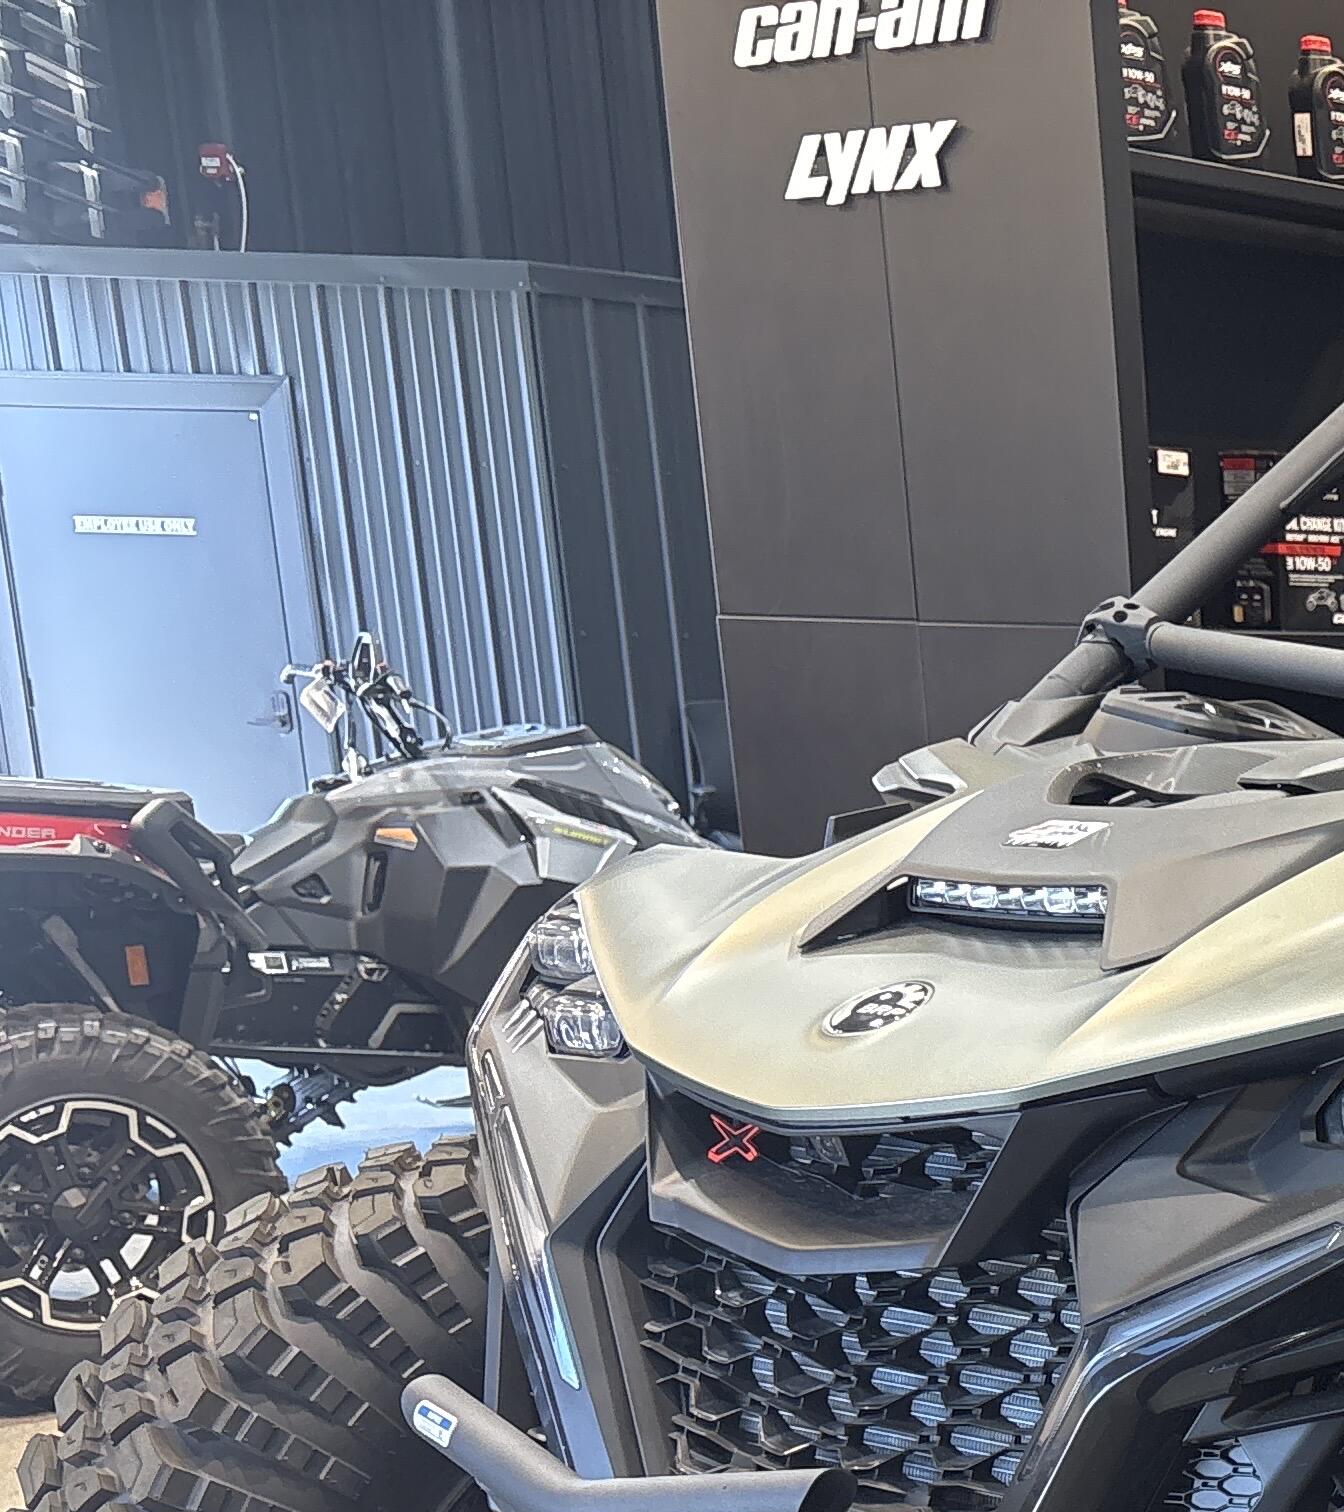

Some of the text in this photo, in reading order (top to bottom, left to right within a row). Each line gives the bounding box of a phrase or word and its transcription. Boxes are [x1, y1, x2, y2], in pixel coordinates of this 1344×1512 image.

[734, 0, 986, 67] can-am
[784, 119, 958, 206] LYNX
[0, 826, 56, 839] NDER
[856, 1002, 907, 1017] BRP
